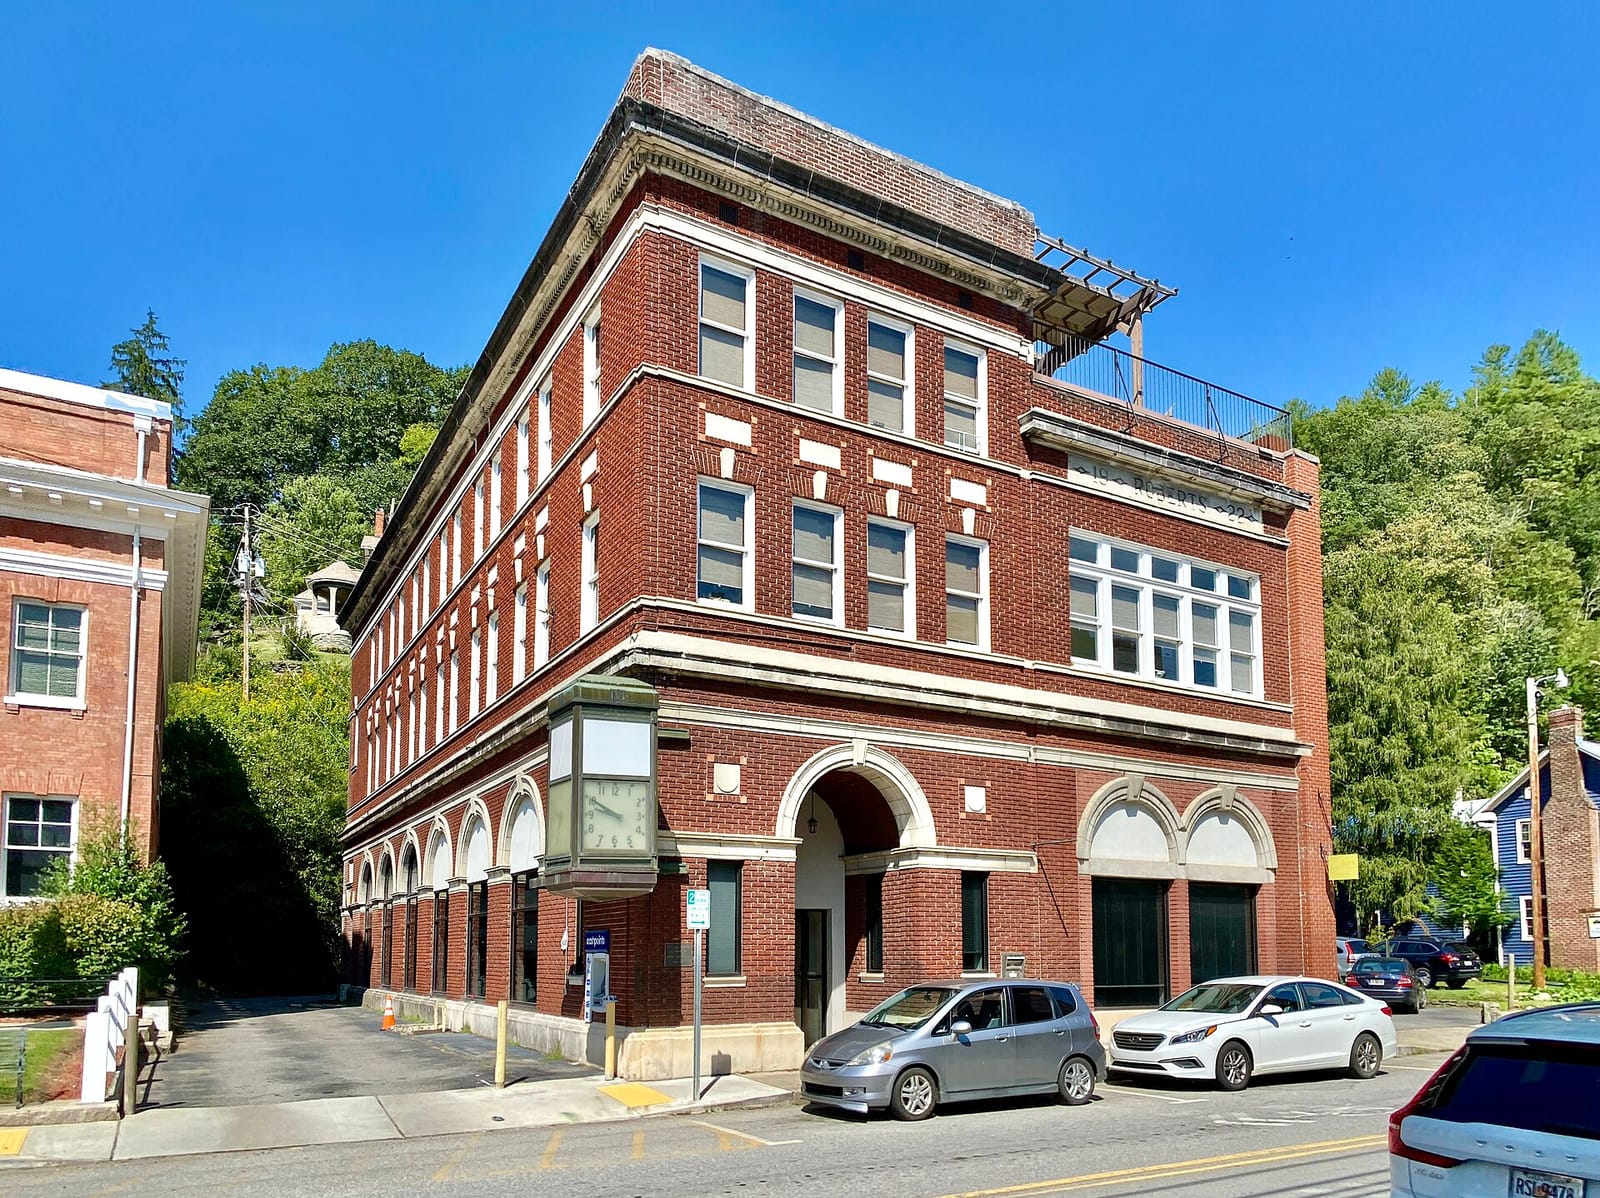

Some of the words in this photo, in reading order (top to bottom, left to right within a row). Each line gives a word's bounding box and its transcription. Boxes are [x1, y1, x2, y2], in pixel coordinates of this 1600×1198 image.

[1092, 465, 1108, 485] 19
[1134, 477, 1208, 513] ROBERTS
[1228, 505, 1245, 524] 22
[598, 785, 605, 796] 11
[612, 786, 620, 796] 12
[636, 798, 641, 808] 2
[588, 810, 594, 820] 9
[635, 811, 641, 822] 3
[588, 823, 594, 834] 8
[635, 825, 641, 835] 4
[598, 834, 604, 845] 7
[611, 835, 618, 845] 6
[626, 835, 633, 845] 5
